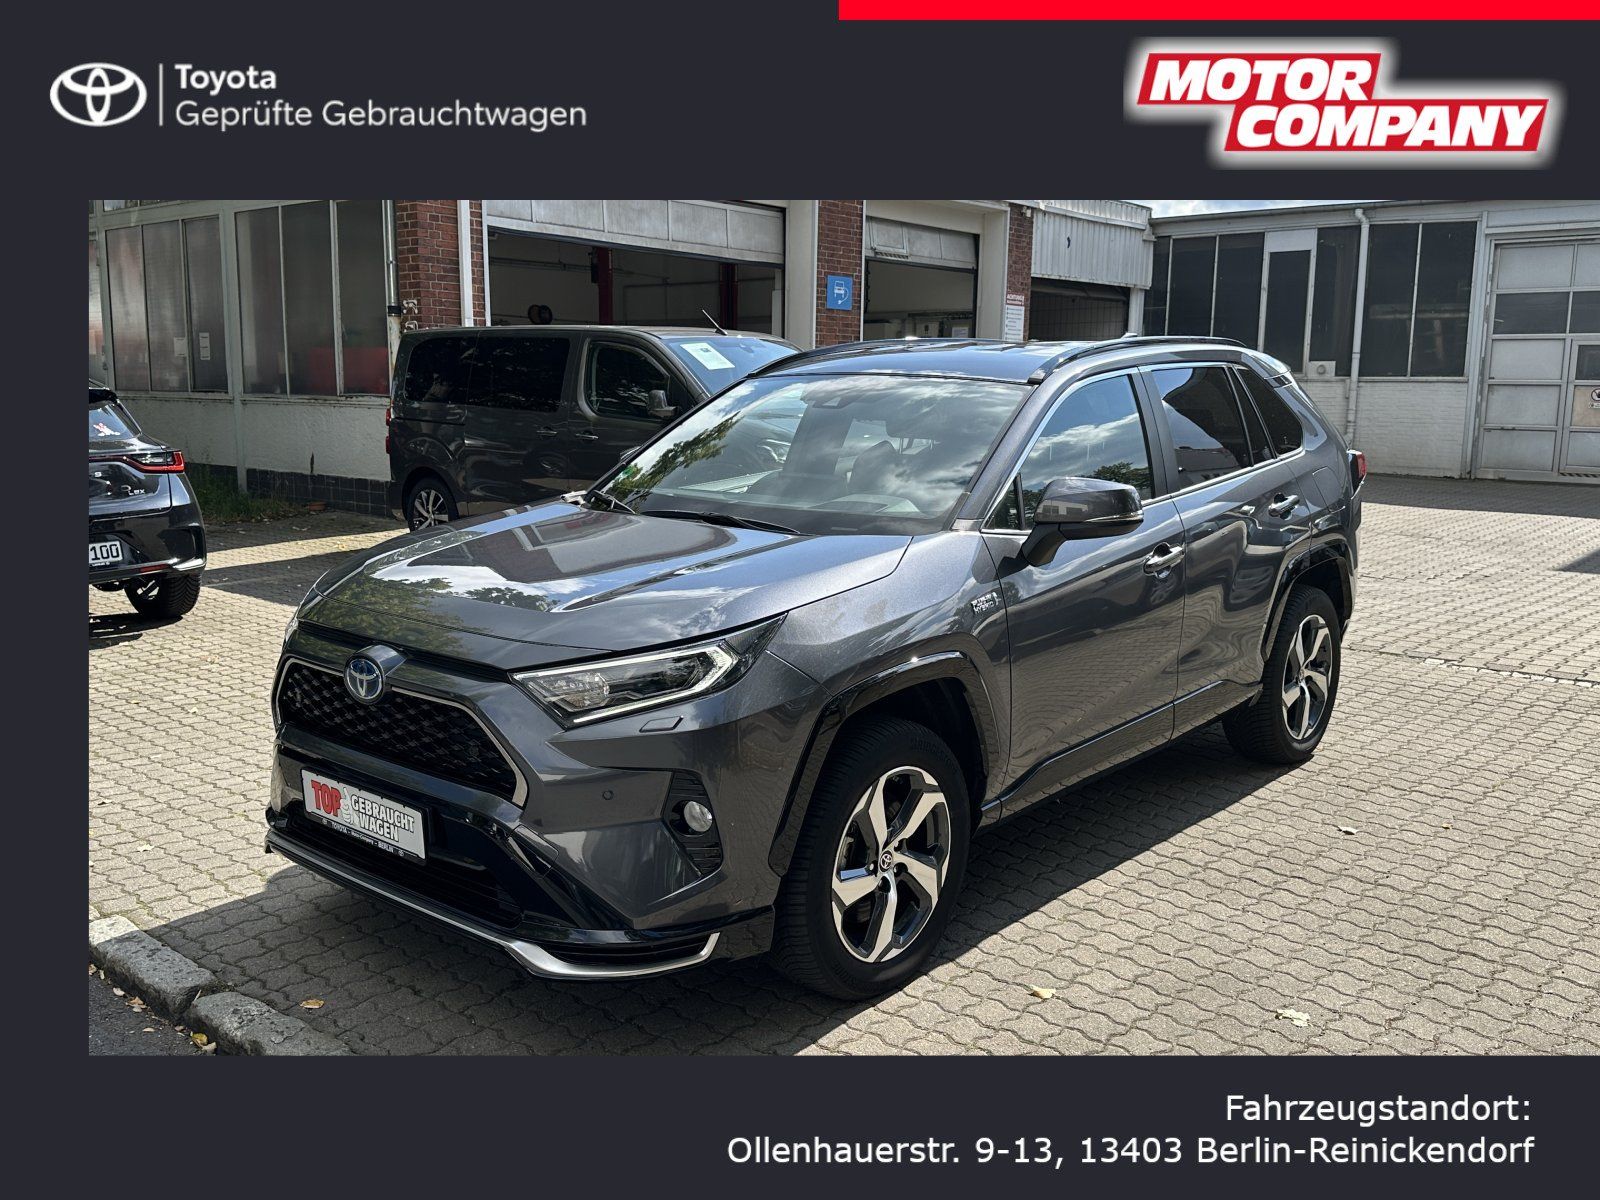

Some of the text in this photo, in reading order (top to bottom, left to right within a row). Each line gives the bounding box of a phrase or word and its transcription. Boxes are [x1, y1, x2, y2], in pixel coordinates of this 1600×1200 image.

[90, 543, 120, 561] 100
[311, 780, 342, 817] TOP
[351, 794, 415, 833] GEBRAUCHT
[331, 821, 348, 833] TOYOTA
[378, 841, 394, 854] BERLIN
[359, 812, 399, 842] WAGEN
